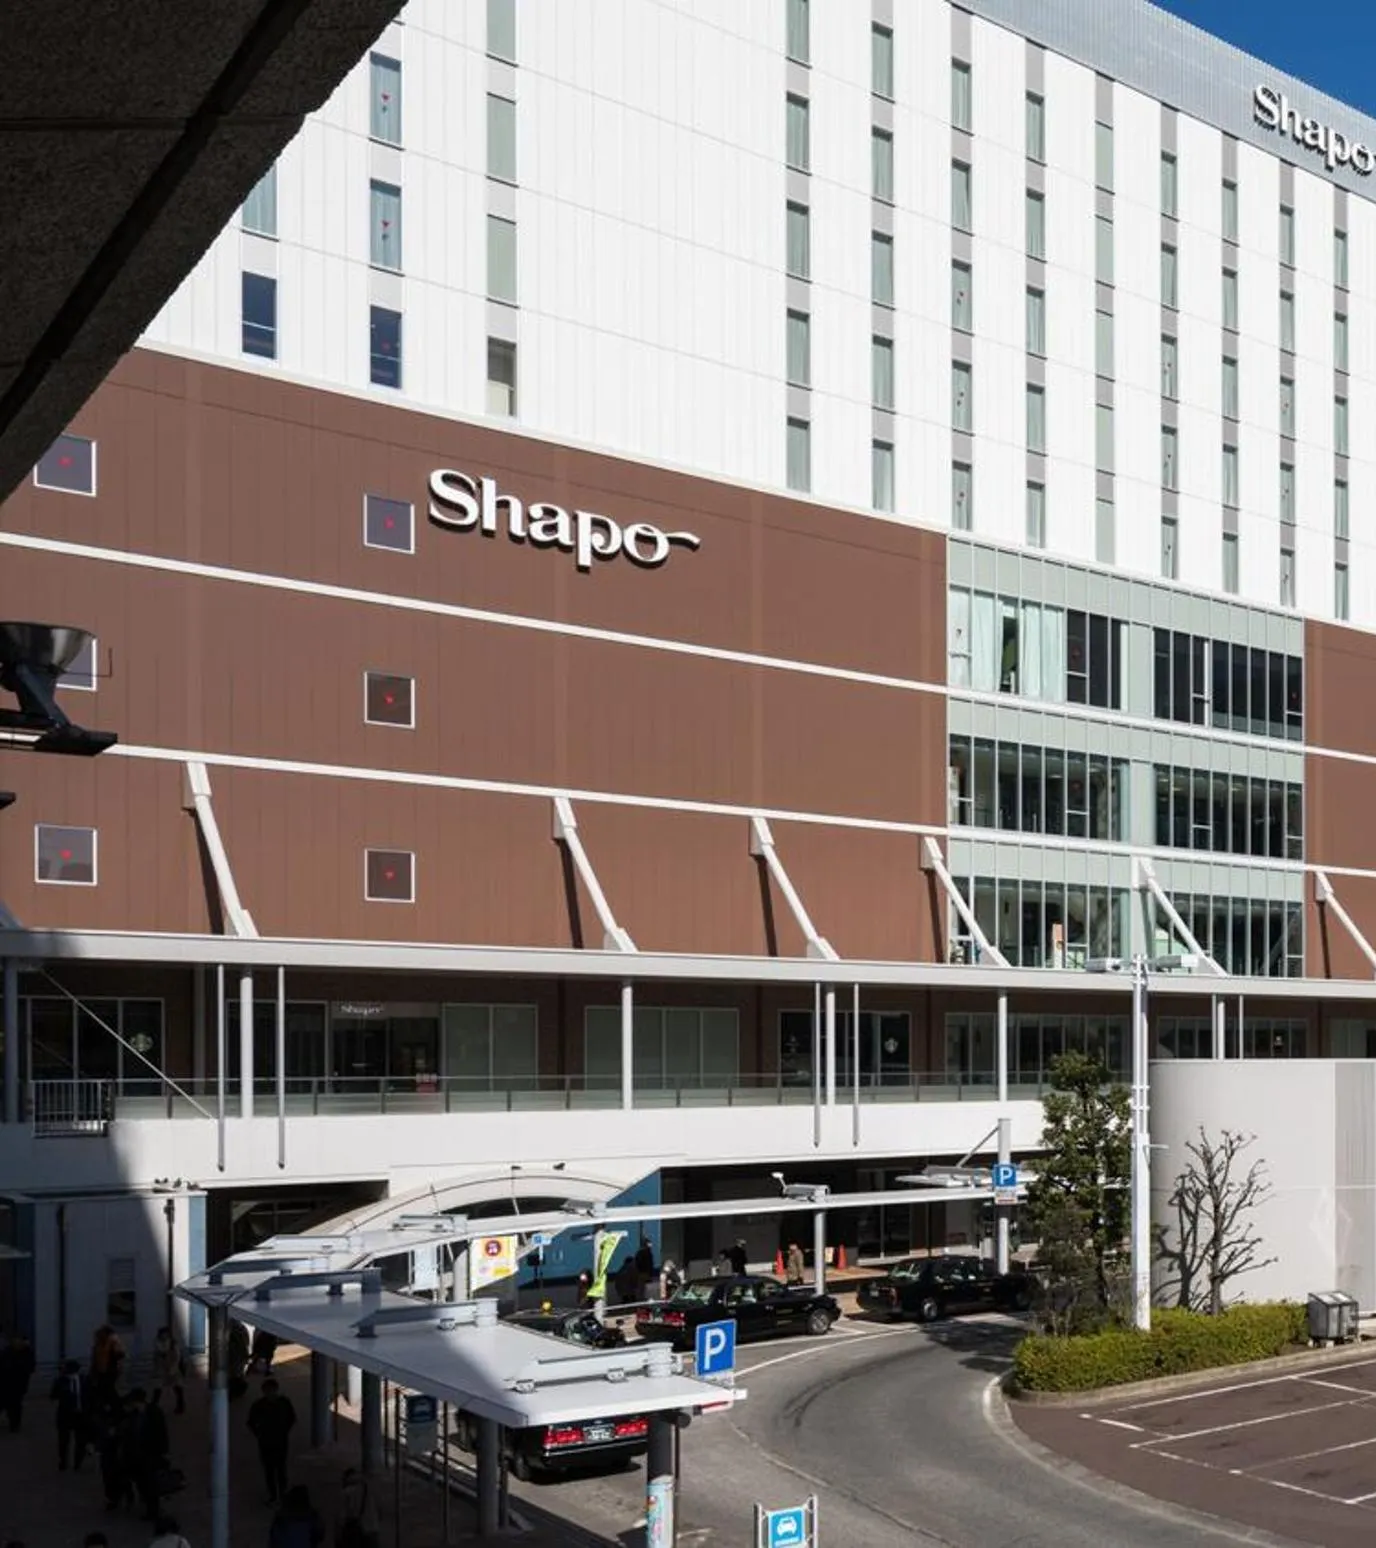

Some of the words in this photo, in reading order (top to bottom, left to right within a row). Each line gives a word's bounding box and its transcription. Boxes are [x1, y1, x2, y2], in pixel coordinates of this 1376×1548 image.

[428, 468, 700, 571] Shapo
[1000, 1167, 1013, 1185] P
[704, 1328, 727, 1370] P
